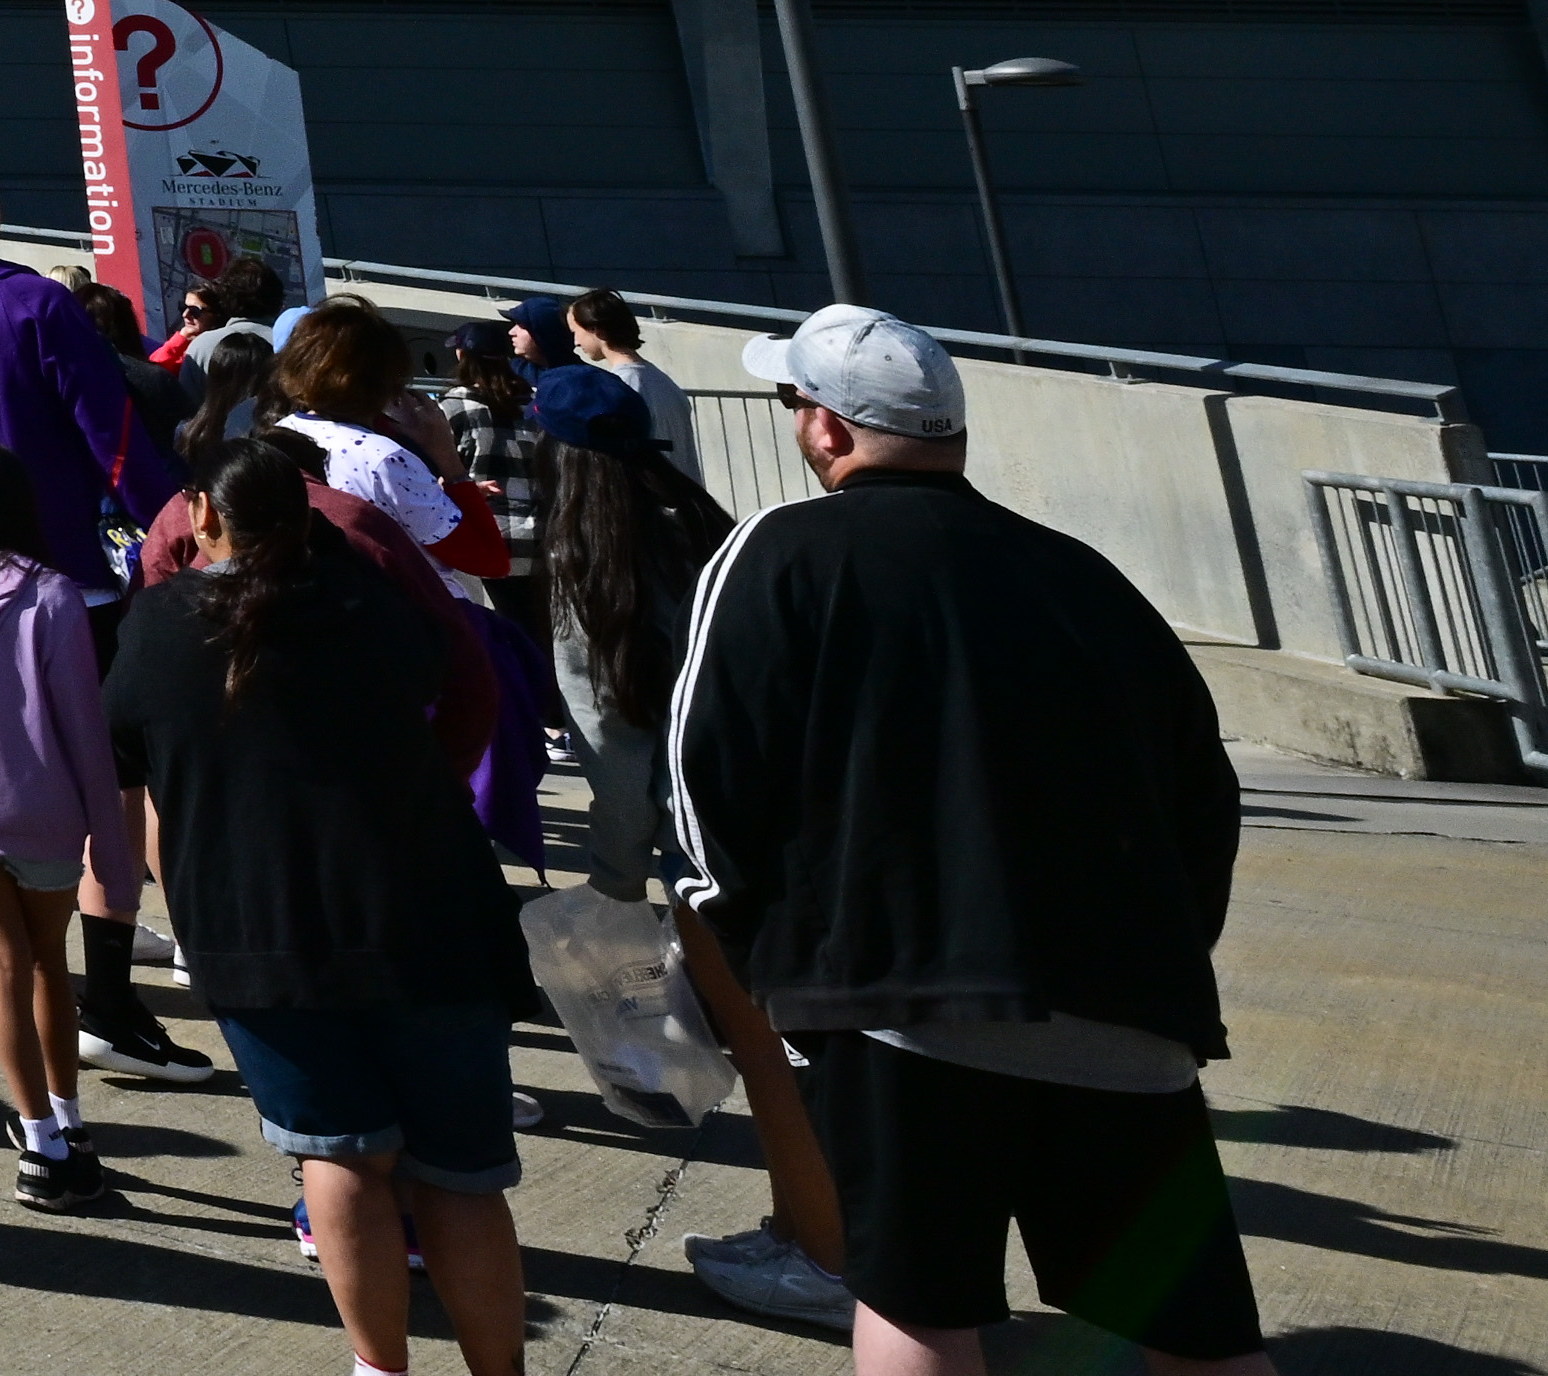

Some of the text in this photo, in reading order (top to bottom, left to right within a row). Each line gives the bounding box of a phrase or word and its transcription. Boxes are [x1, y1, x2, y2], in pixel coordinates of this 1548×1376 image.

[69, 33, 118, 256] information
[162, 179, 283, 197] Mercedes-Benz
[188, 198, 258, 207] STADIUM
[922, 418, 952, 433] USA
